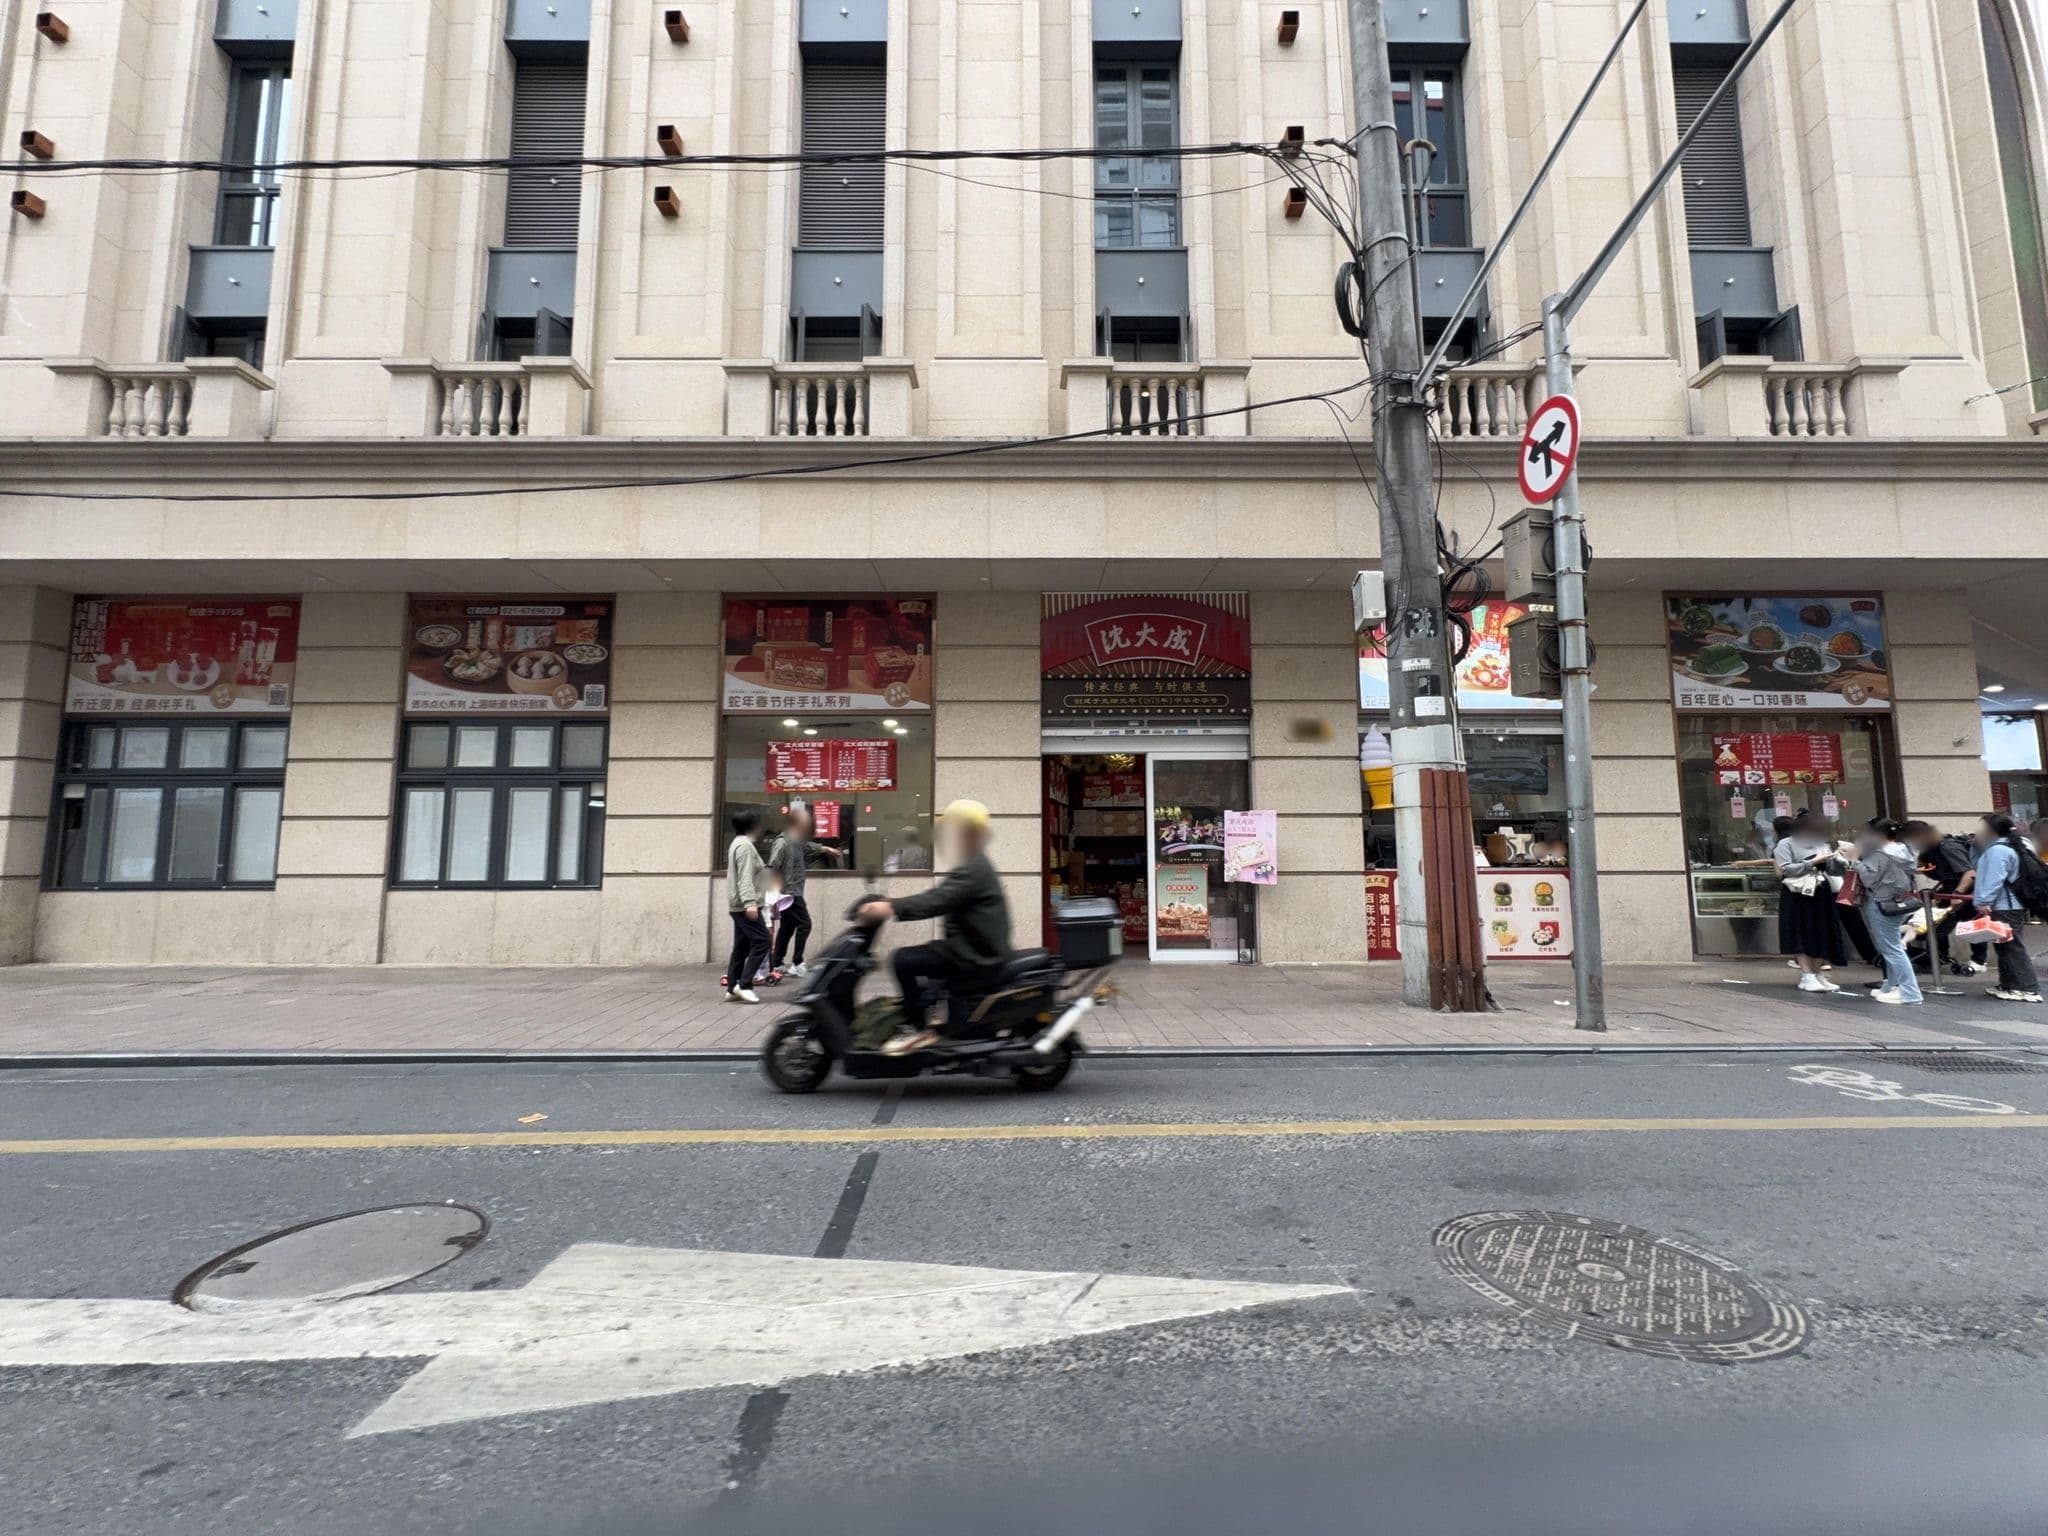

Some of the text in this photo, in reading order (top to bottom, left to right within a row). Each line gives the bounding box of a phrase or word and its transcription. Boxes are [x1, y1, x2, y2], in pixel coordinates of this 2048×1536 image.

[1101, 622, 1192, 656] 沈大成
[1084, 681, 1208, 693] 传承经典 与时俱进
[1680, 694, 1808, 706] 百年匠心 一口知春味
[1379, 893, 1392, 949] 浓情上海味
